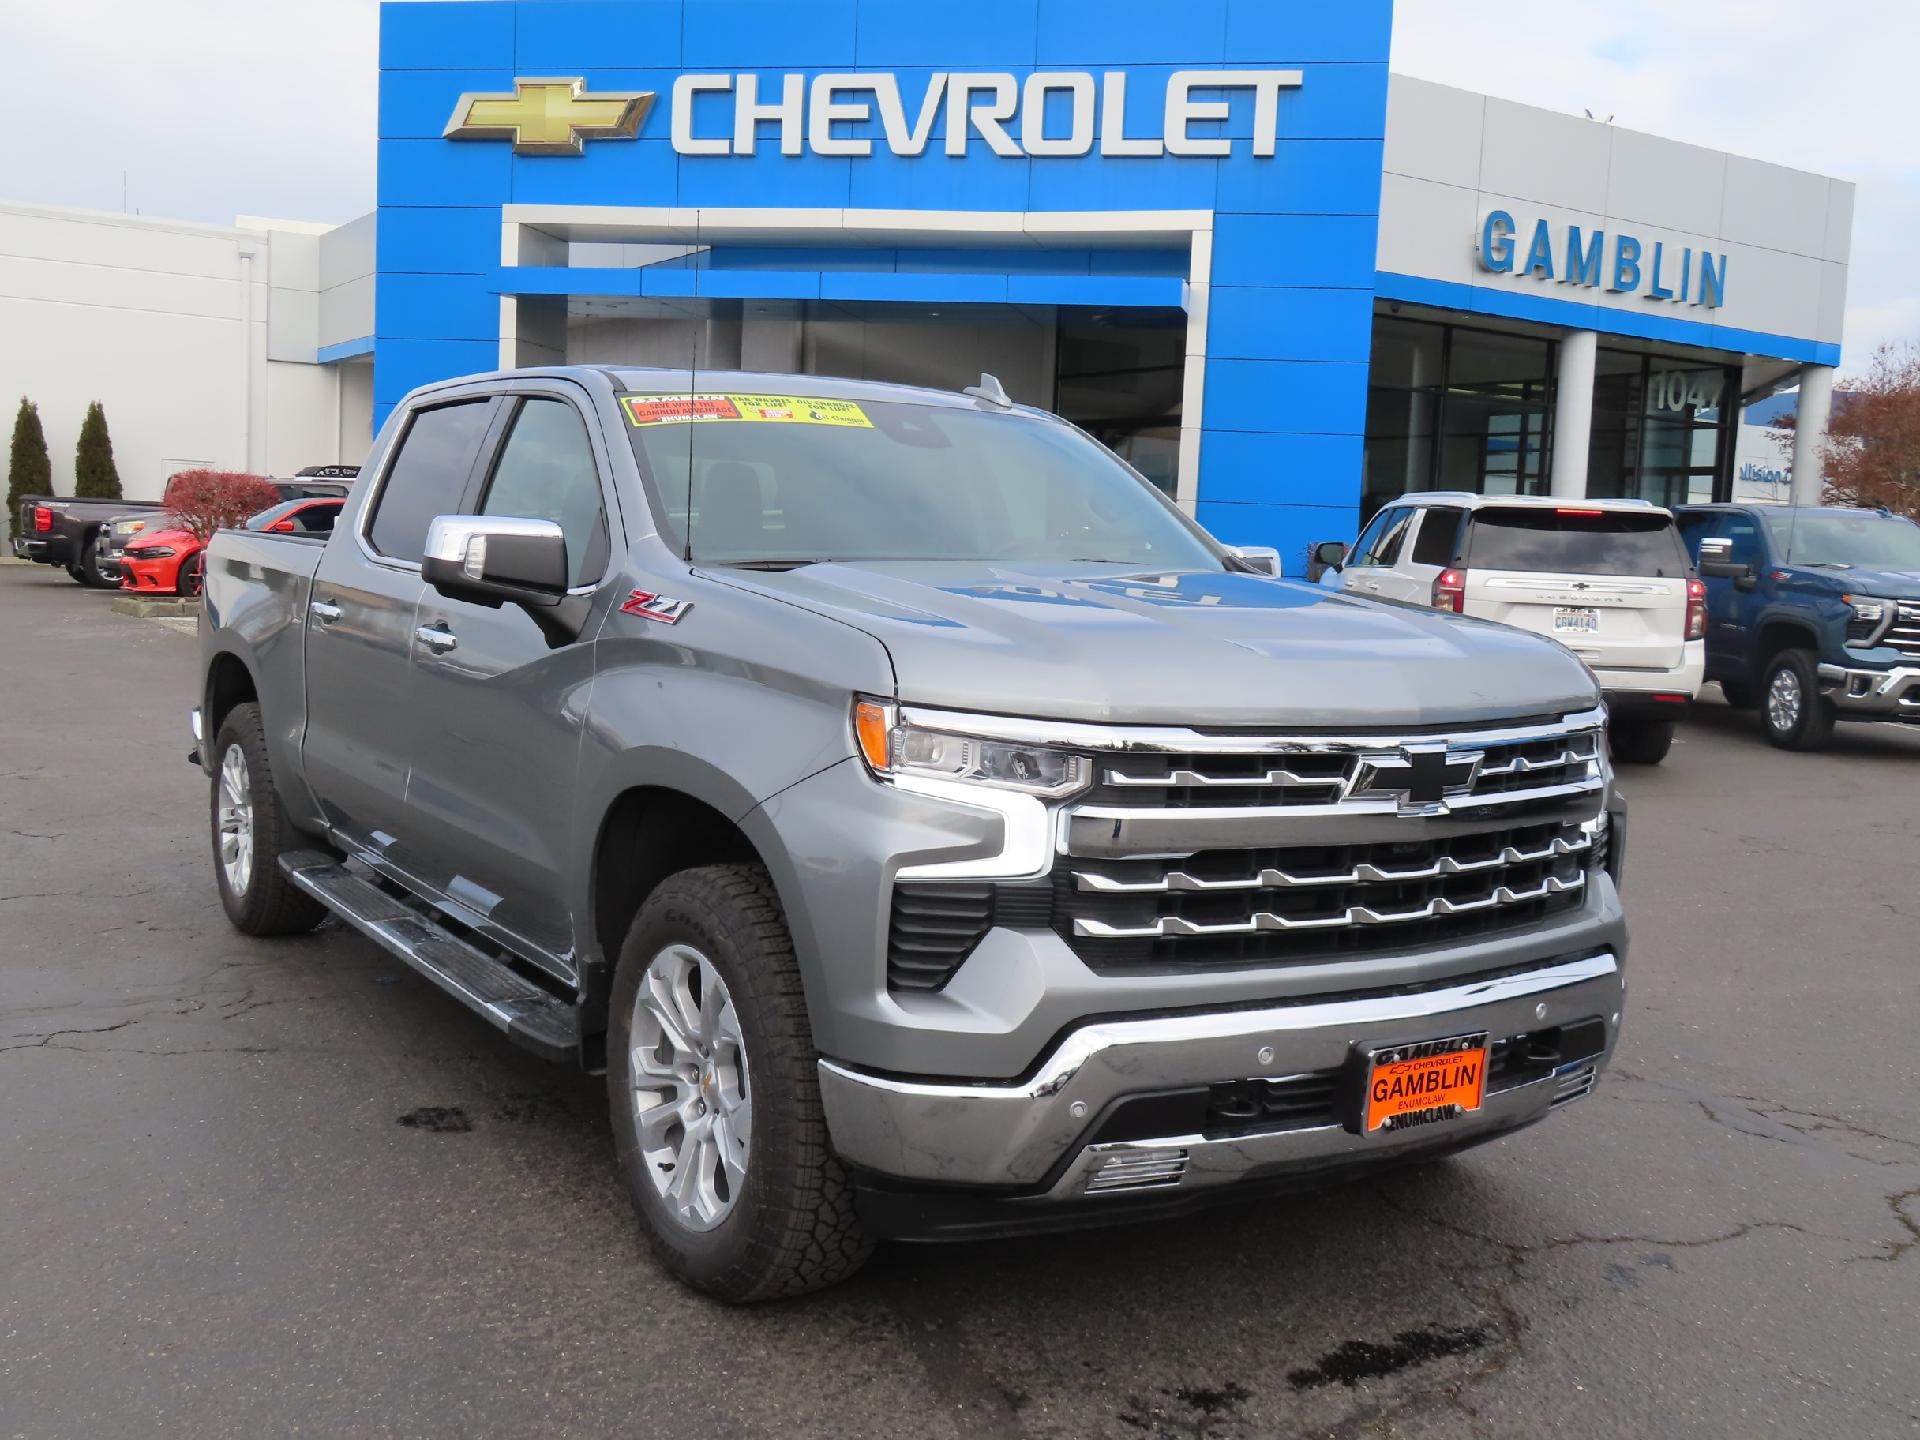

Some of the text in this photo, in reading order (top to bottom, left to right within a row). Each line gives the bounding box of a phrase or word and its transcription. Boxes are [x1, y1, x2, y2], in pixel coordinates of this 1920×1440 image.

[671, 69, 1303, 159] CHEVROLET
[1478, 210, 1727, 309] GAMBLIN
[1655, 369, 1726, 413] 1047
[682, 407, 733, 415] ADVANTAGE
[619, 588, 694, 625] Z71
[1413, 1056, 1464, 1071] CHEVROLET
[1373, 1063, 1476, 1103] GAMBLIN
[1389, 1104, 1457, 1132] ENUMCLAW
[1398, 1094, 1446, 1110] ENUMCLAW
